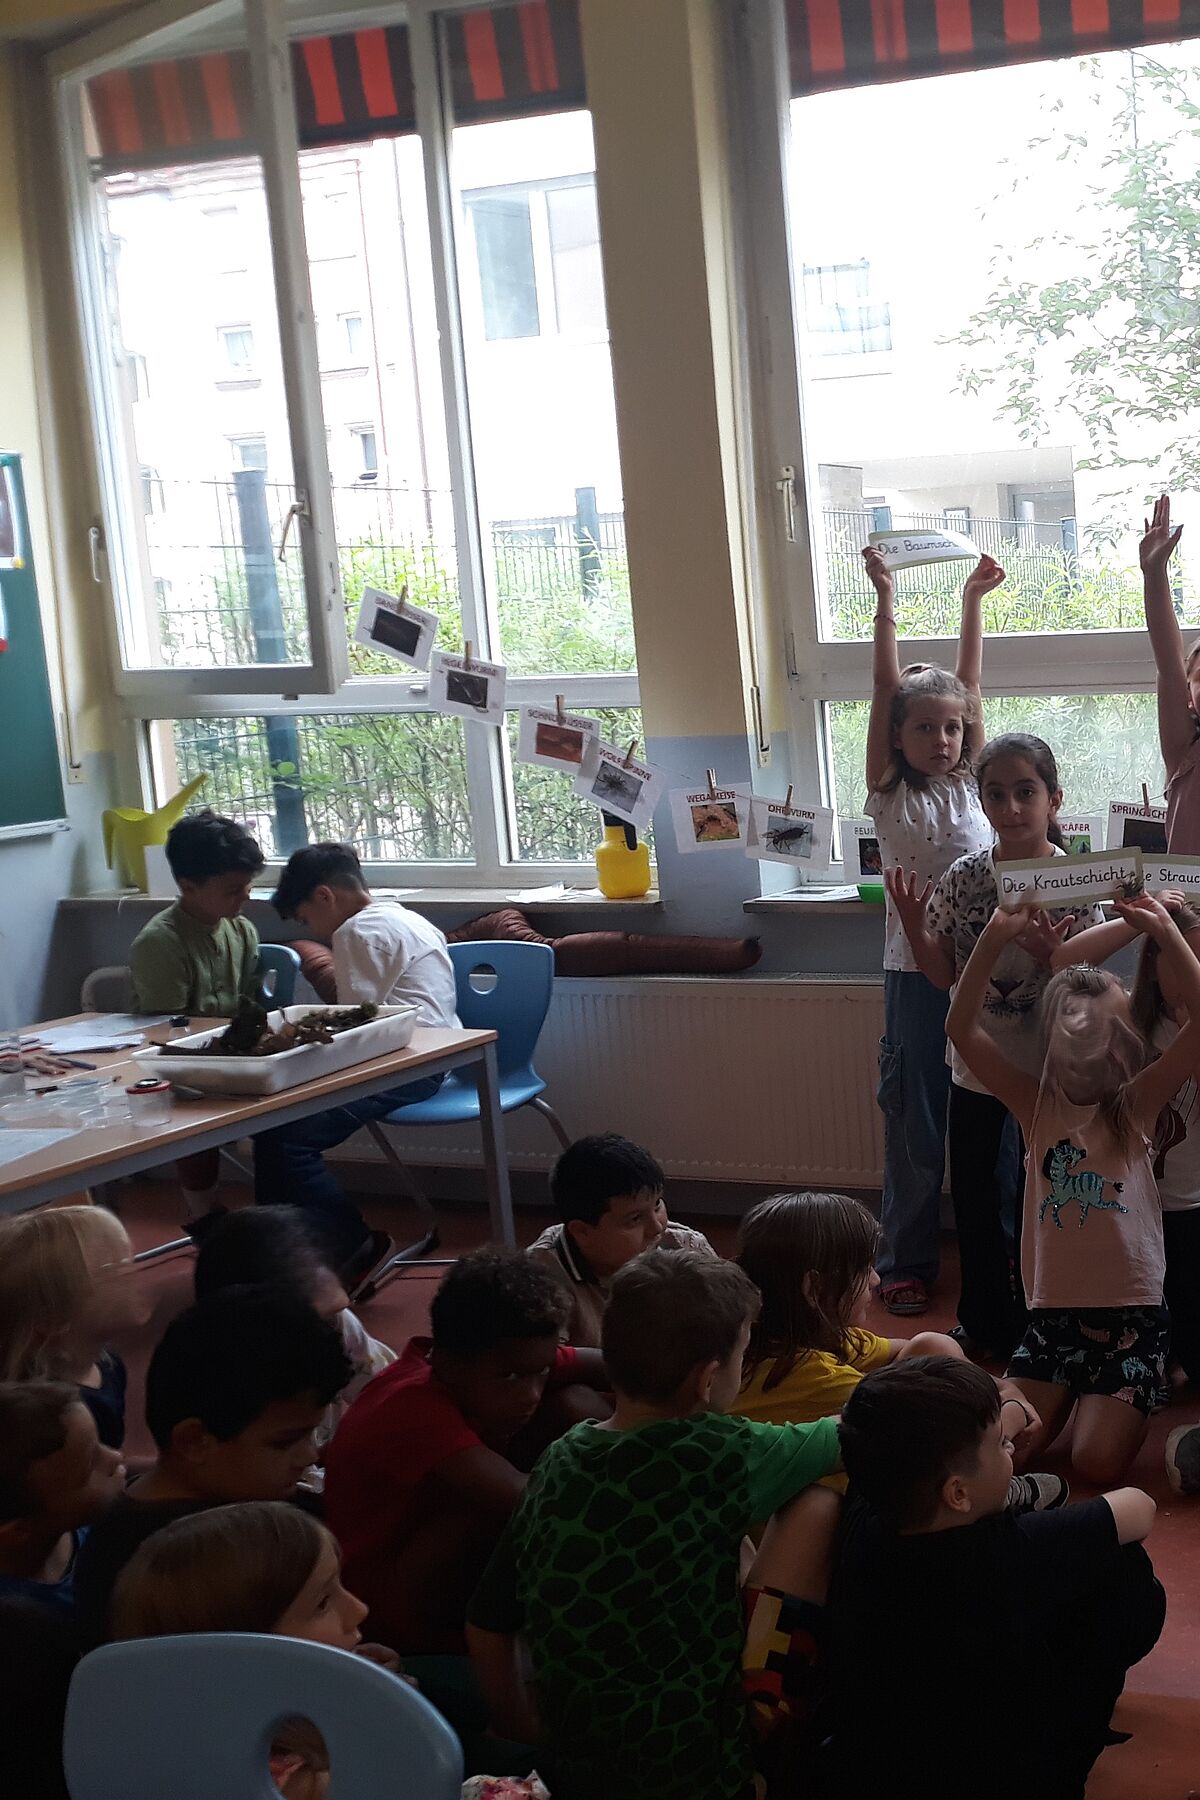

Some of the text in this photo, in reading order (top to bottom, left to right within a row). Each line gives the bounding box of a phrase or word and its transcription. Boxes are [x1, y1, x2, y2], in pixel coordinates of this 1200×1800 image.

[878, 542, 899, 555] Die
[1002, 878, 1027, 894] Die
[1034, 866, 1126, 891] Krautschicht
